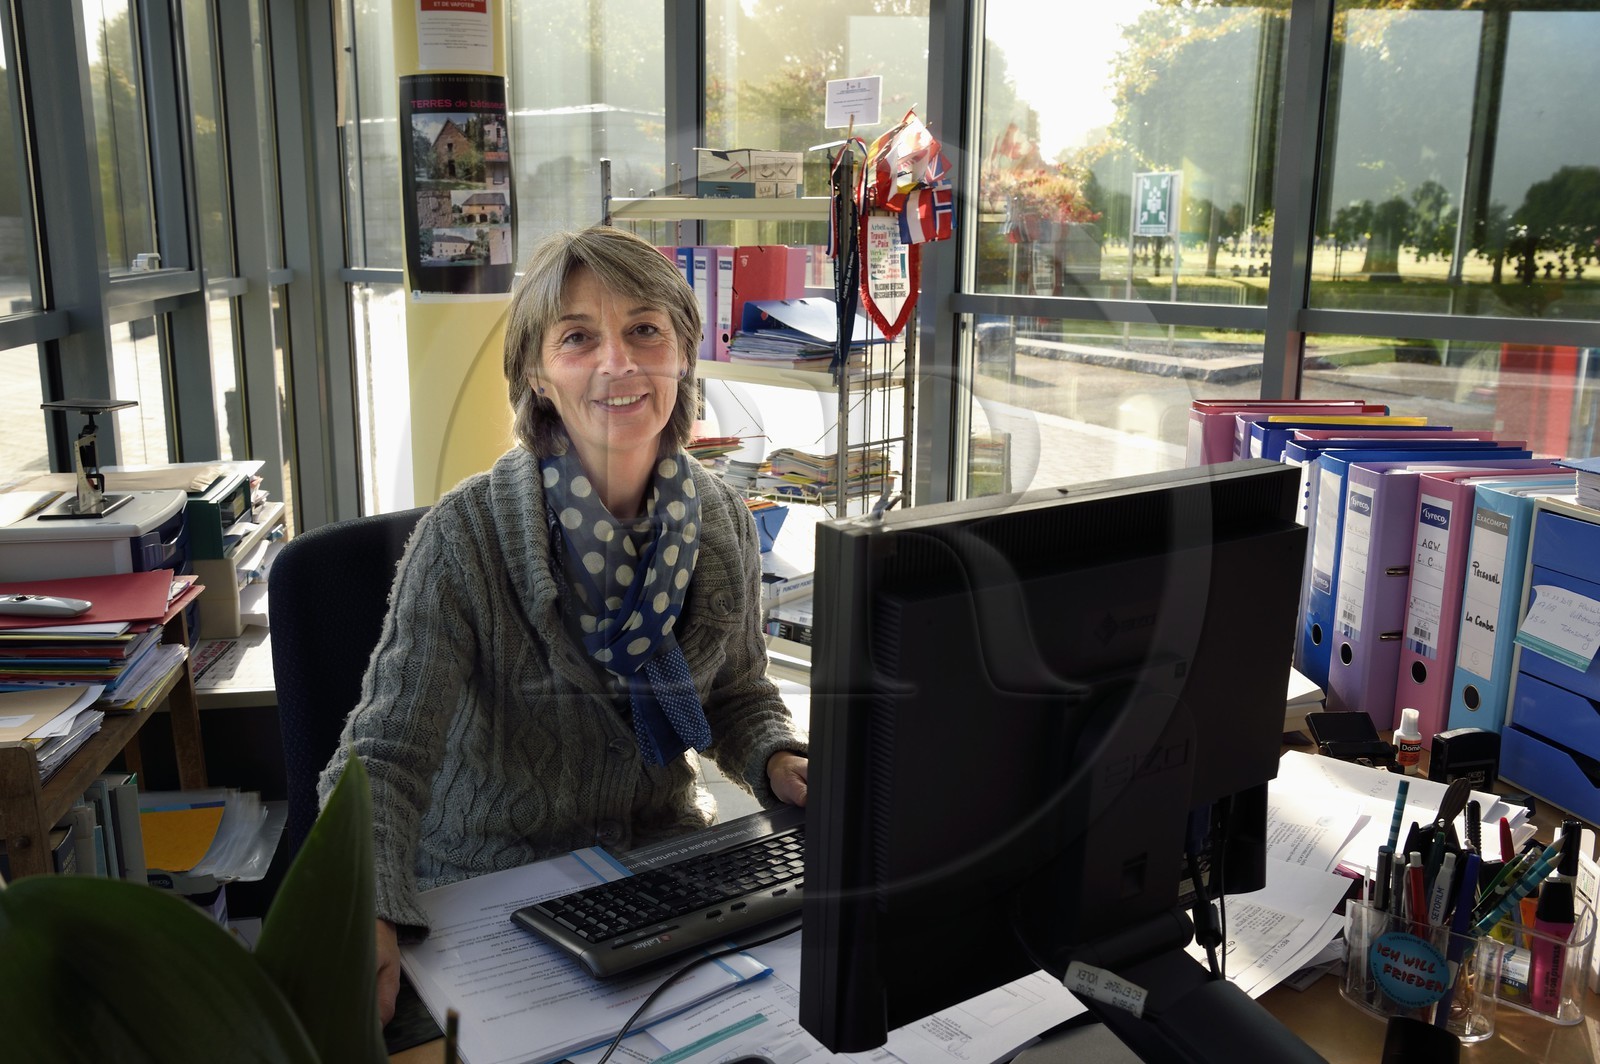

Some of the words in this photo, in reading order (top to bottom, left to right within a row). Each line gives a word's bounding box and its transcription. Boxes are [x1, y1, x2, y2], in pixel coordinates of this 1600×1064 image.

[410, 99, 452, 108] TERRES
[455, 100, 468, 108] de
[871, 232, 887, 240] Travail
[1423, 508, 1447, 524] Lyreco
[1476, 513, 1508, 530] EXACOMPTA
[689, 838, 718, 852] digitale
[650, 850, 678, 864] surtout
[1431, 887, 1445, 921] SETOFILM
[632, 936, 662, 950] Labtec
[1376, 943, 1401, 962] ICH
[1404, 954, 1436, 974] WILL
[1076, 969, 1098, 985] VOLEX
[1384, 963, 1446, 993] FRIEDEN
